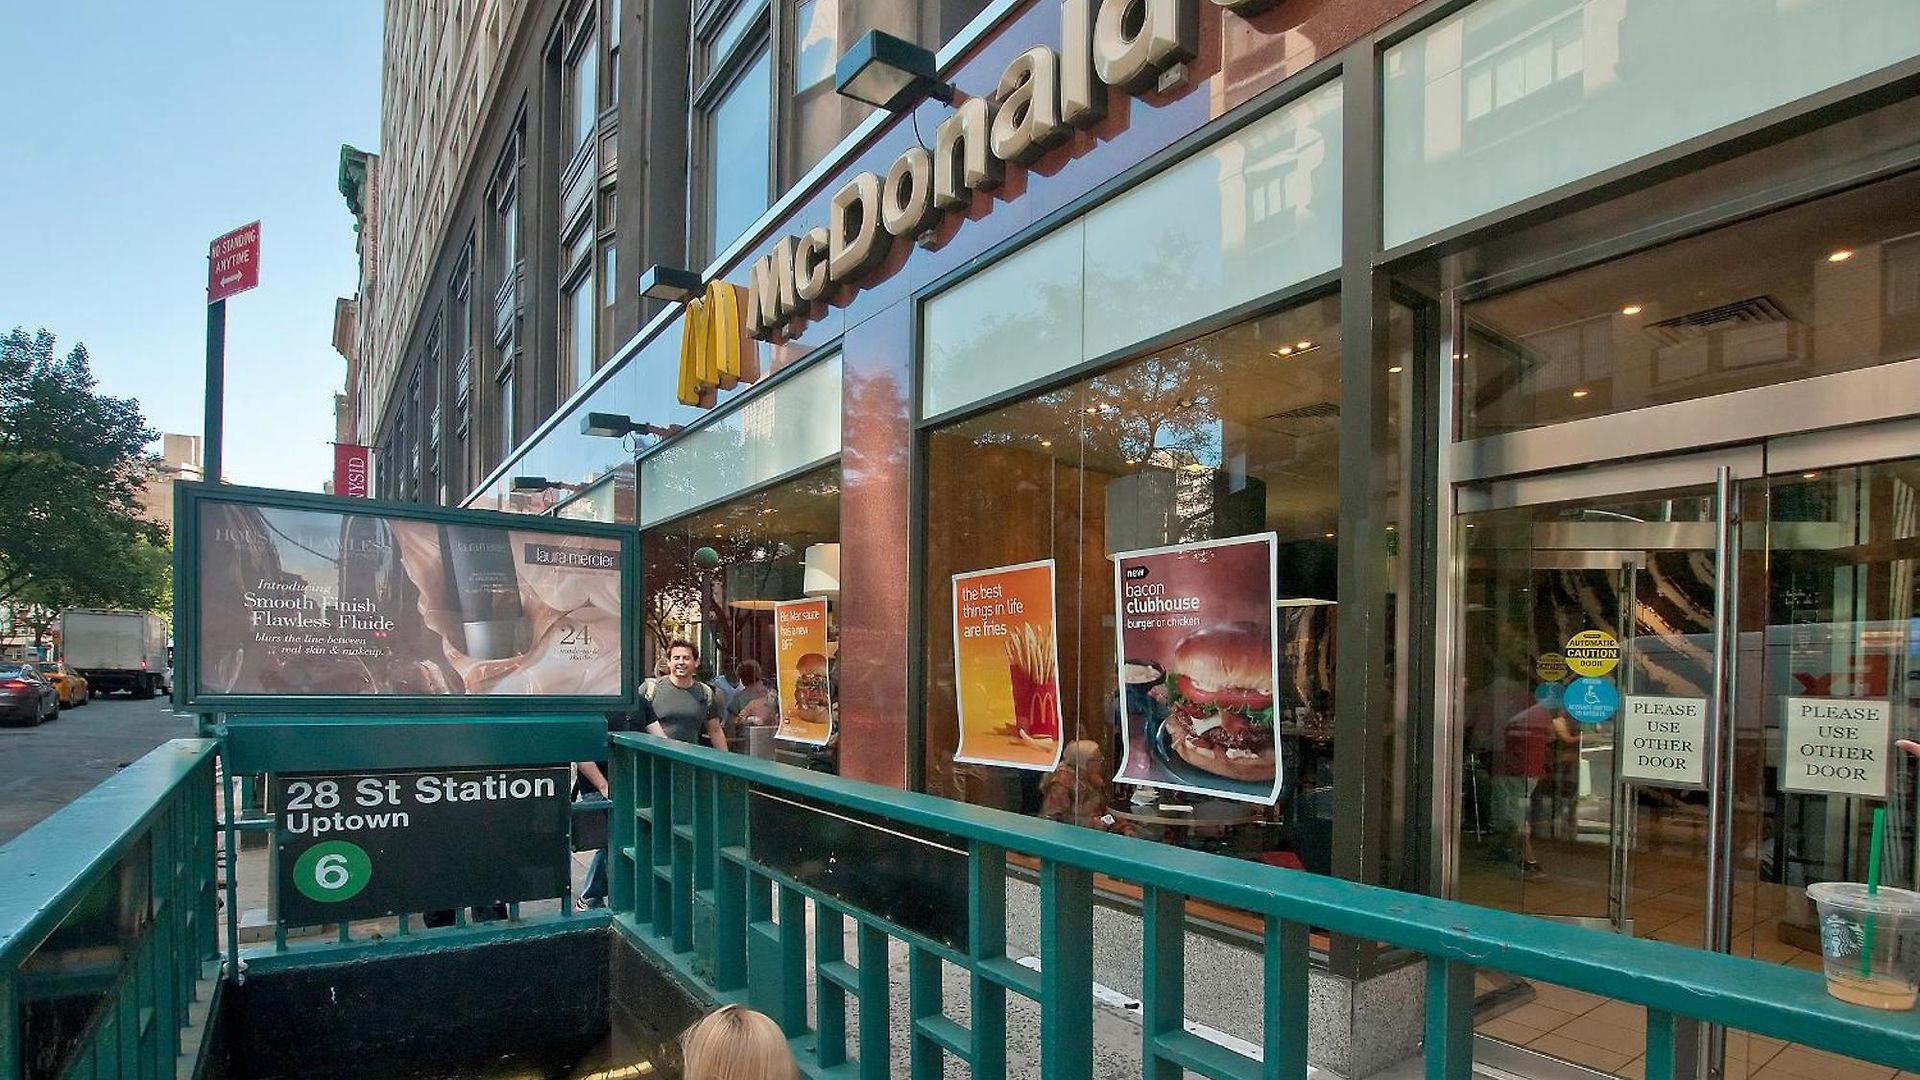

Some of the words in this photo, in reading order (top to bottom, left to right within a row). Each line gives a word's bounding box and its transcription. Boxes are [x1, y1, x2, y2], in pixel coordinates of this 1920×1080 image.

[746, 0, 1240, 342] McDonald
[211, 244, 221, 258] NO
[222, 229, 256, 254] STANDING
[215, 249, 250, 274] ANYTIME
[536, 547, 566, 564] laura
[568, 552, 615, 568] mercier
[1126, 568, 1146, 578] new
[257, 578, 331, 595] Introducing
[962, 587, 979, 602] the
[979, 583, 1003, 600] best
[1125, 582, 1165, 598] bacon
[243, 591, 314, 610] Smooth
[322, 596, 377, 613] Finish
[963, 602, 993, 620] things
[995, 600, 1004, 615] in
[1007, 598, 1024, 614] life
[1126, 596, 1200, 613] clubhouse
[252, 610, 331, 629] Flawless
[338, 614, 395, 631] Fluide
[802, 610, 820, 620] sauce
[1127, 618, 1156, 632] burger
[1156, 618, 1166, 628] or
[1166, 615, 1200, 628] chicken
[559, 623, 592, 646] 24
[964, 625, 981, 638] are
[982, 620, 1007, 637] fries
[255, 632, 281, 643] blurs
[284, 633, 301, 643] the
[303, 634, 325, 645] line
[327, 634, 366, 645] between
[1569, 639, 1615, 647] AUTOMATIC
[281, 645, 301, 654] real
[305, 645, 326, 655] skin
[329, 646, 340, 655] &
[1567, 649, 1617, 658] CAUTION
[1633, 702, 1697, 717] PLEASE
[1801, 705, 1880, 721] PLEASE
[1647, 720, 1680, 733] USE
[1818, 725, 1859, 740] USE
[1633, 737, 1693, 753] OTHER
[1800, 743, 1875, 761] OTHER
[1638, 755, 1687, 770] DOOR
[1806, 764, 1868, 781] DOOR
[286, 780, 341, 810] 28
[355, 777, 401, 807] St
[415, 773, 555, 804] Station
[286, 811, 410, 838] Uptown
[314, 853, 349, 890] 6
